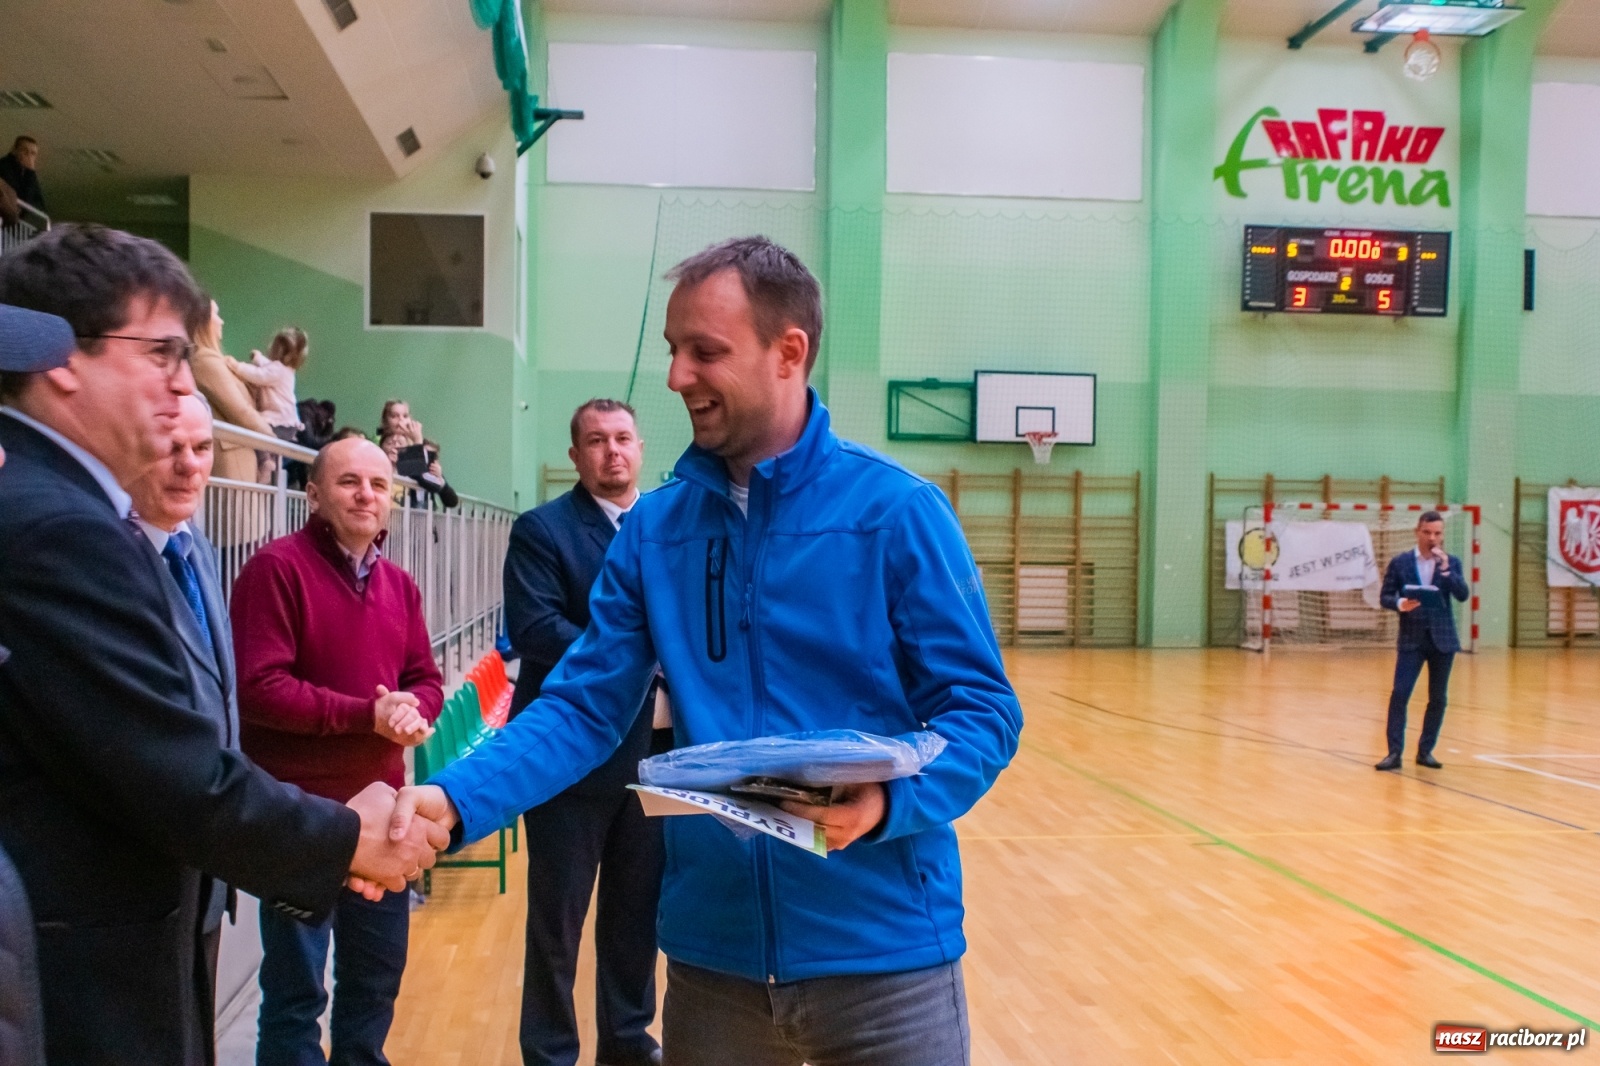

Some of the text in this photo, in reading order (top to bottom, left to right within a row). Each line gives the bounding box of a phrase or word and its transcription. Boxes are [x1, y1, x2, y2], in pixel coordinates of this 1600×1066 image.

[1262, 108, 1446, 163] RAFAKO
[1213, 106, 1451, 208] Arena
[1293, 287, 1307, 307] 3
[1378, 289, 1391, 309] 5
[1289, 561, 1316, 578] JEST
[1320, 556, 1332, 567] W
[661, 787, 796, 840] DYPLOM
